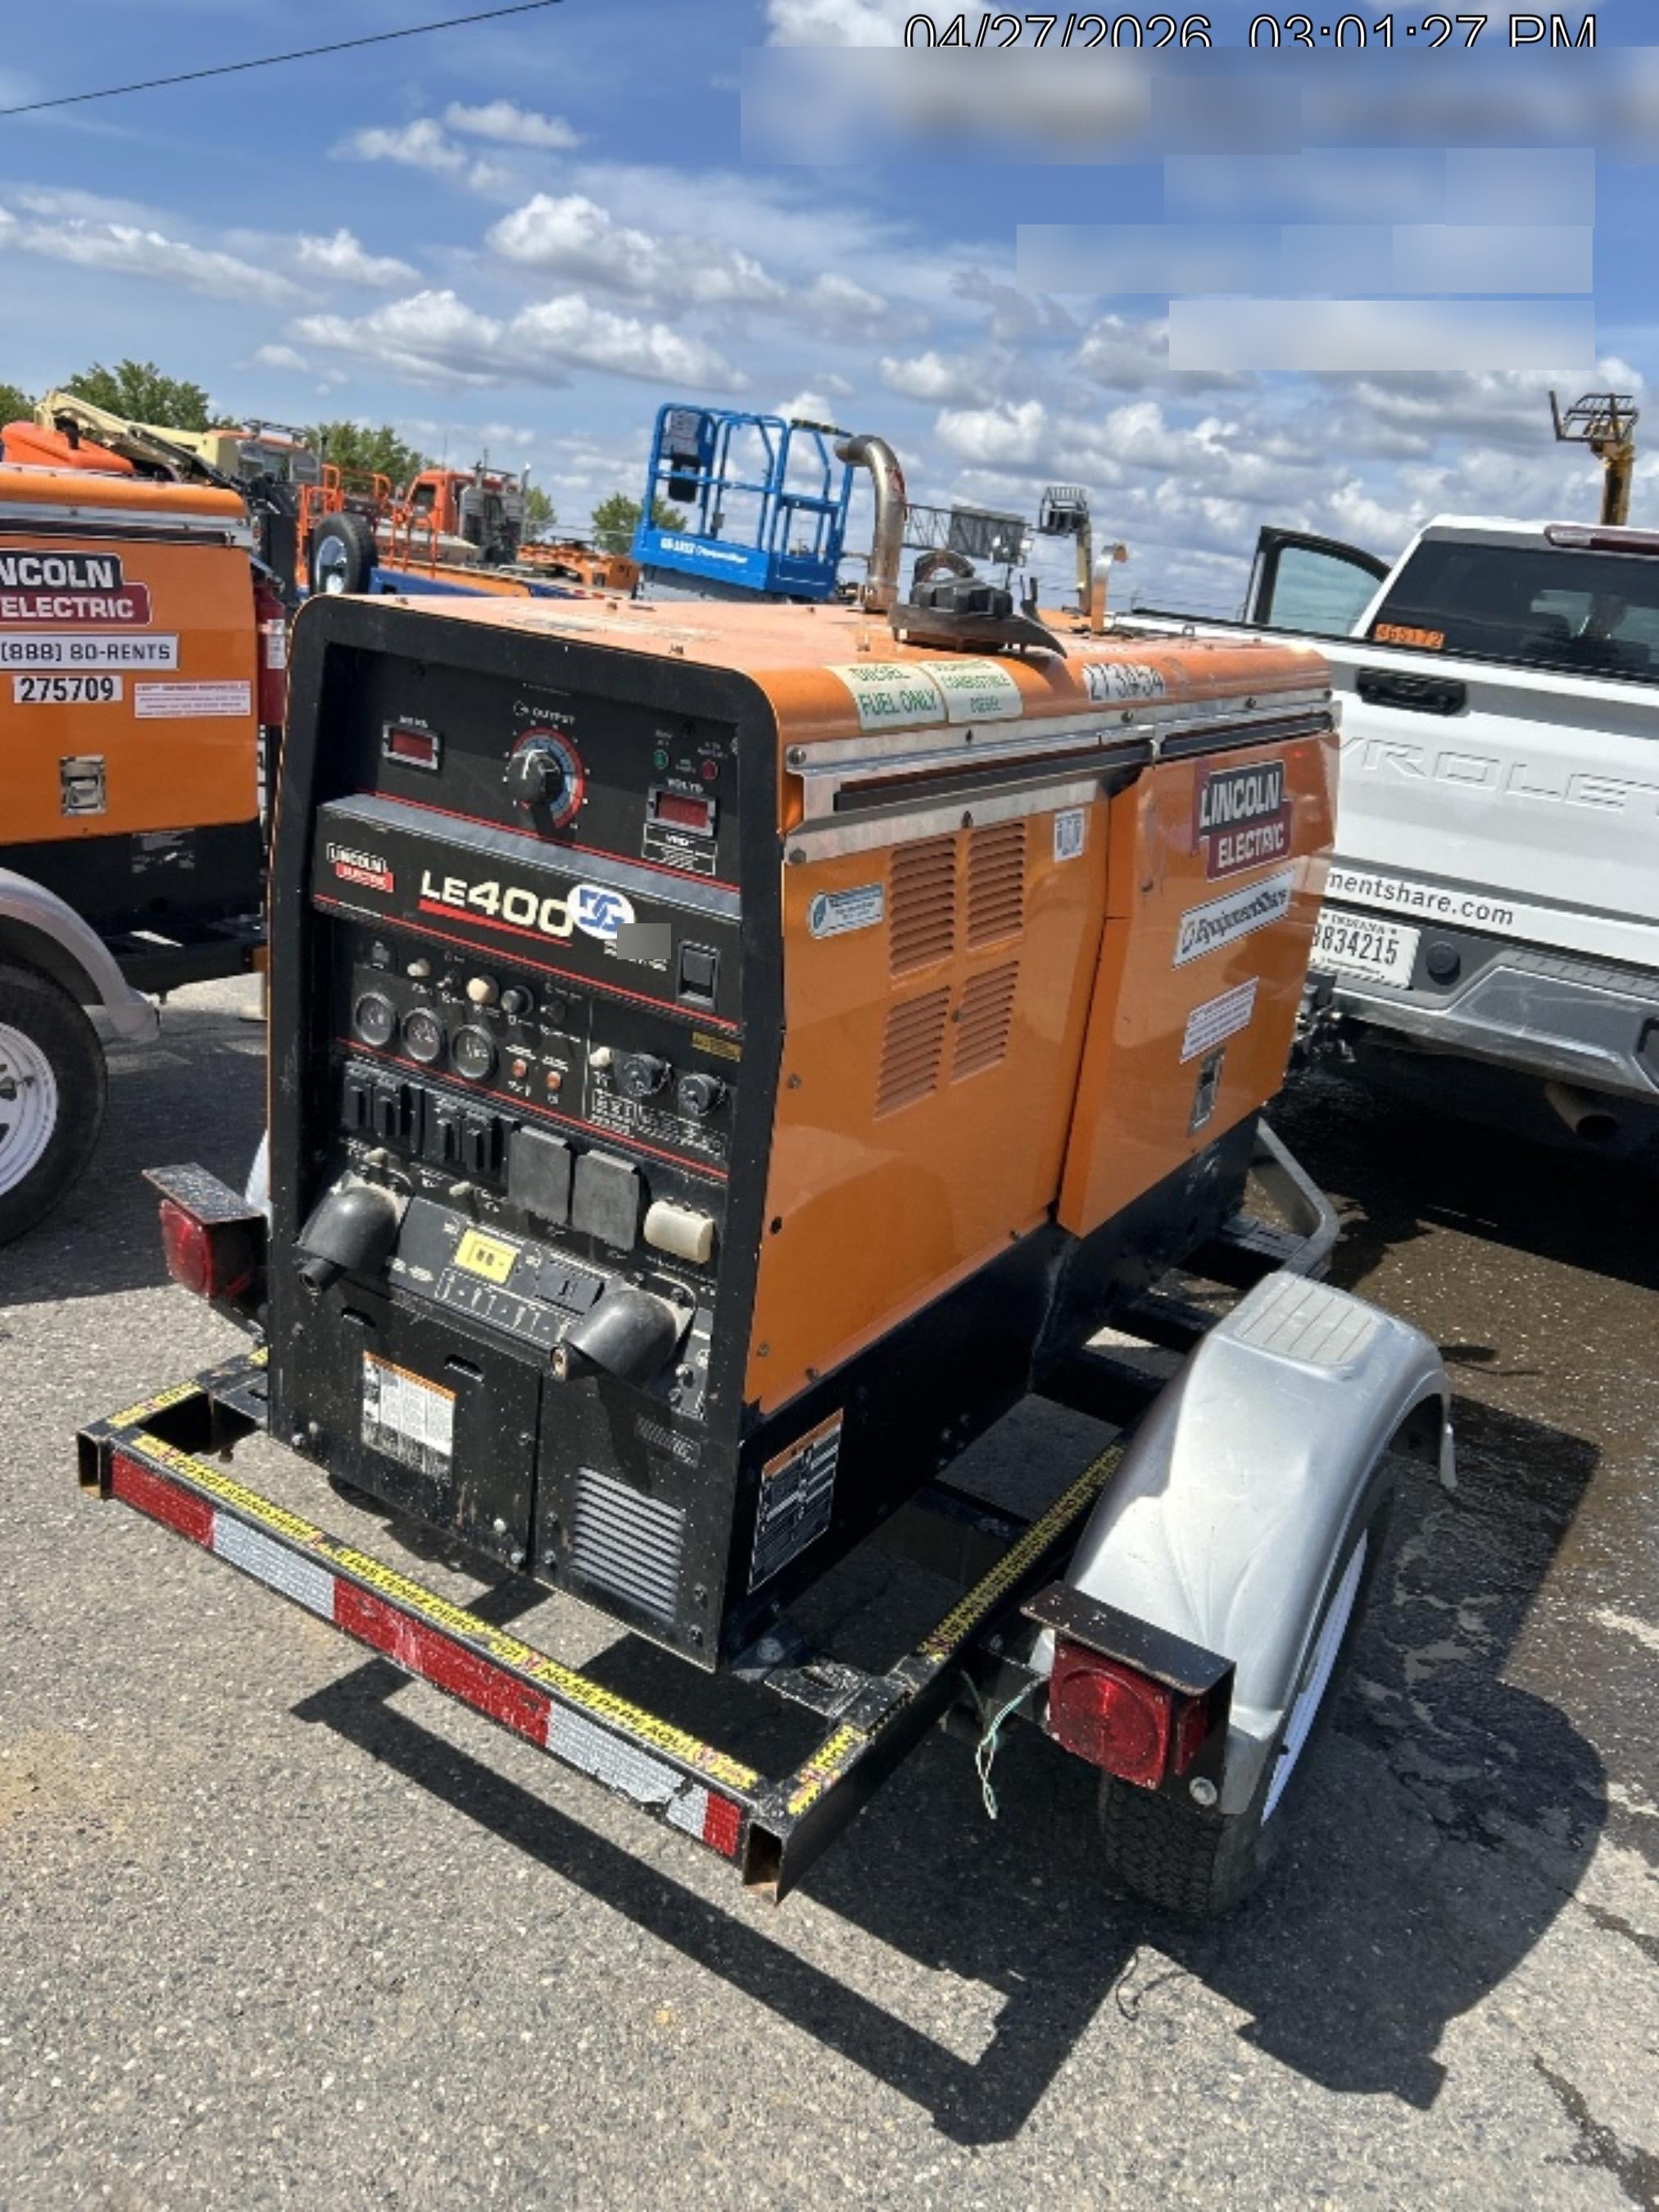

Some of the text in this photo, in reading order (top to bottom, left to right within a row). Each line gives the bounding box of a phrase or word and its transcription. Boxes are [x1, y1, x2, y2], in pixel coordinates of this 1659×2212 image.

[0, 556, 114, 588] NCOLN
[2, 596, 134, 619] ELECTRIC
[70, 643, 170, 661] 80-RENTS
[20, 677, 115, 701] 275709
[859, 691, 937, 716] FUEL ONLY
[1199, 771, 1280, 828] LINCOLN
[1217, 821, 1285, 868] ELECTRIC
[419, 869, 573, 938] LE400
